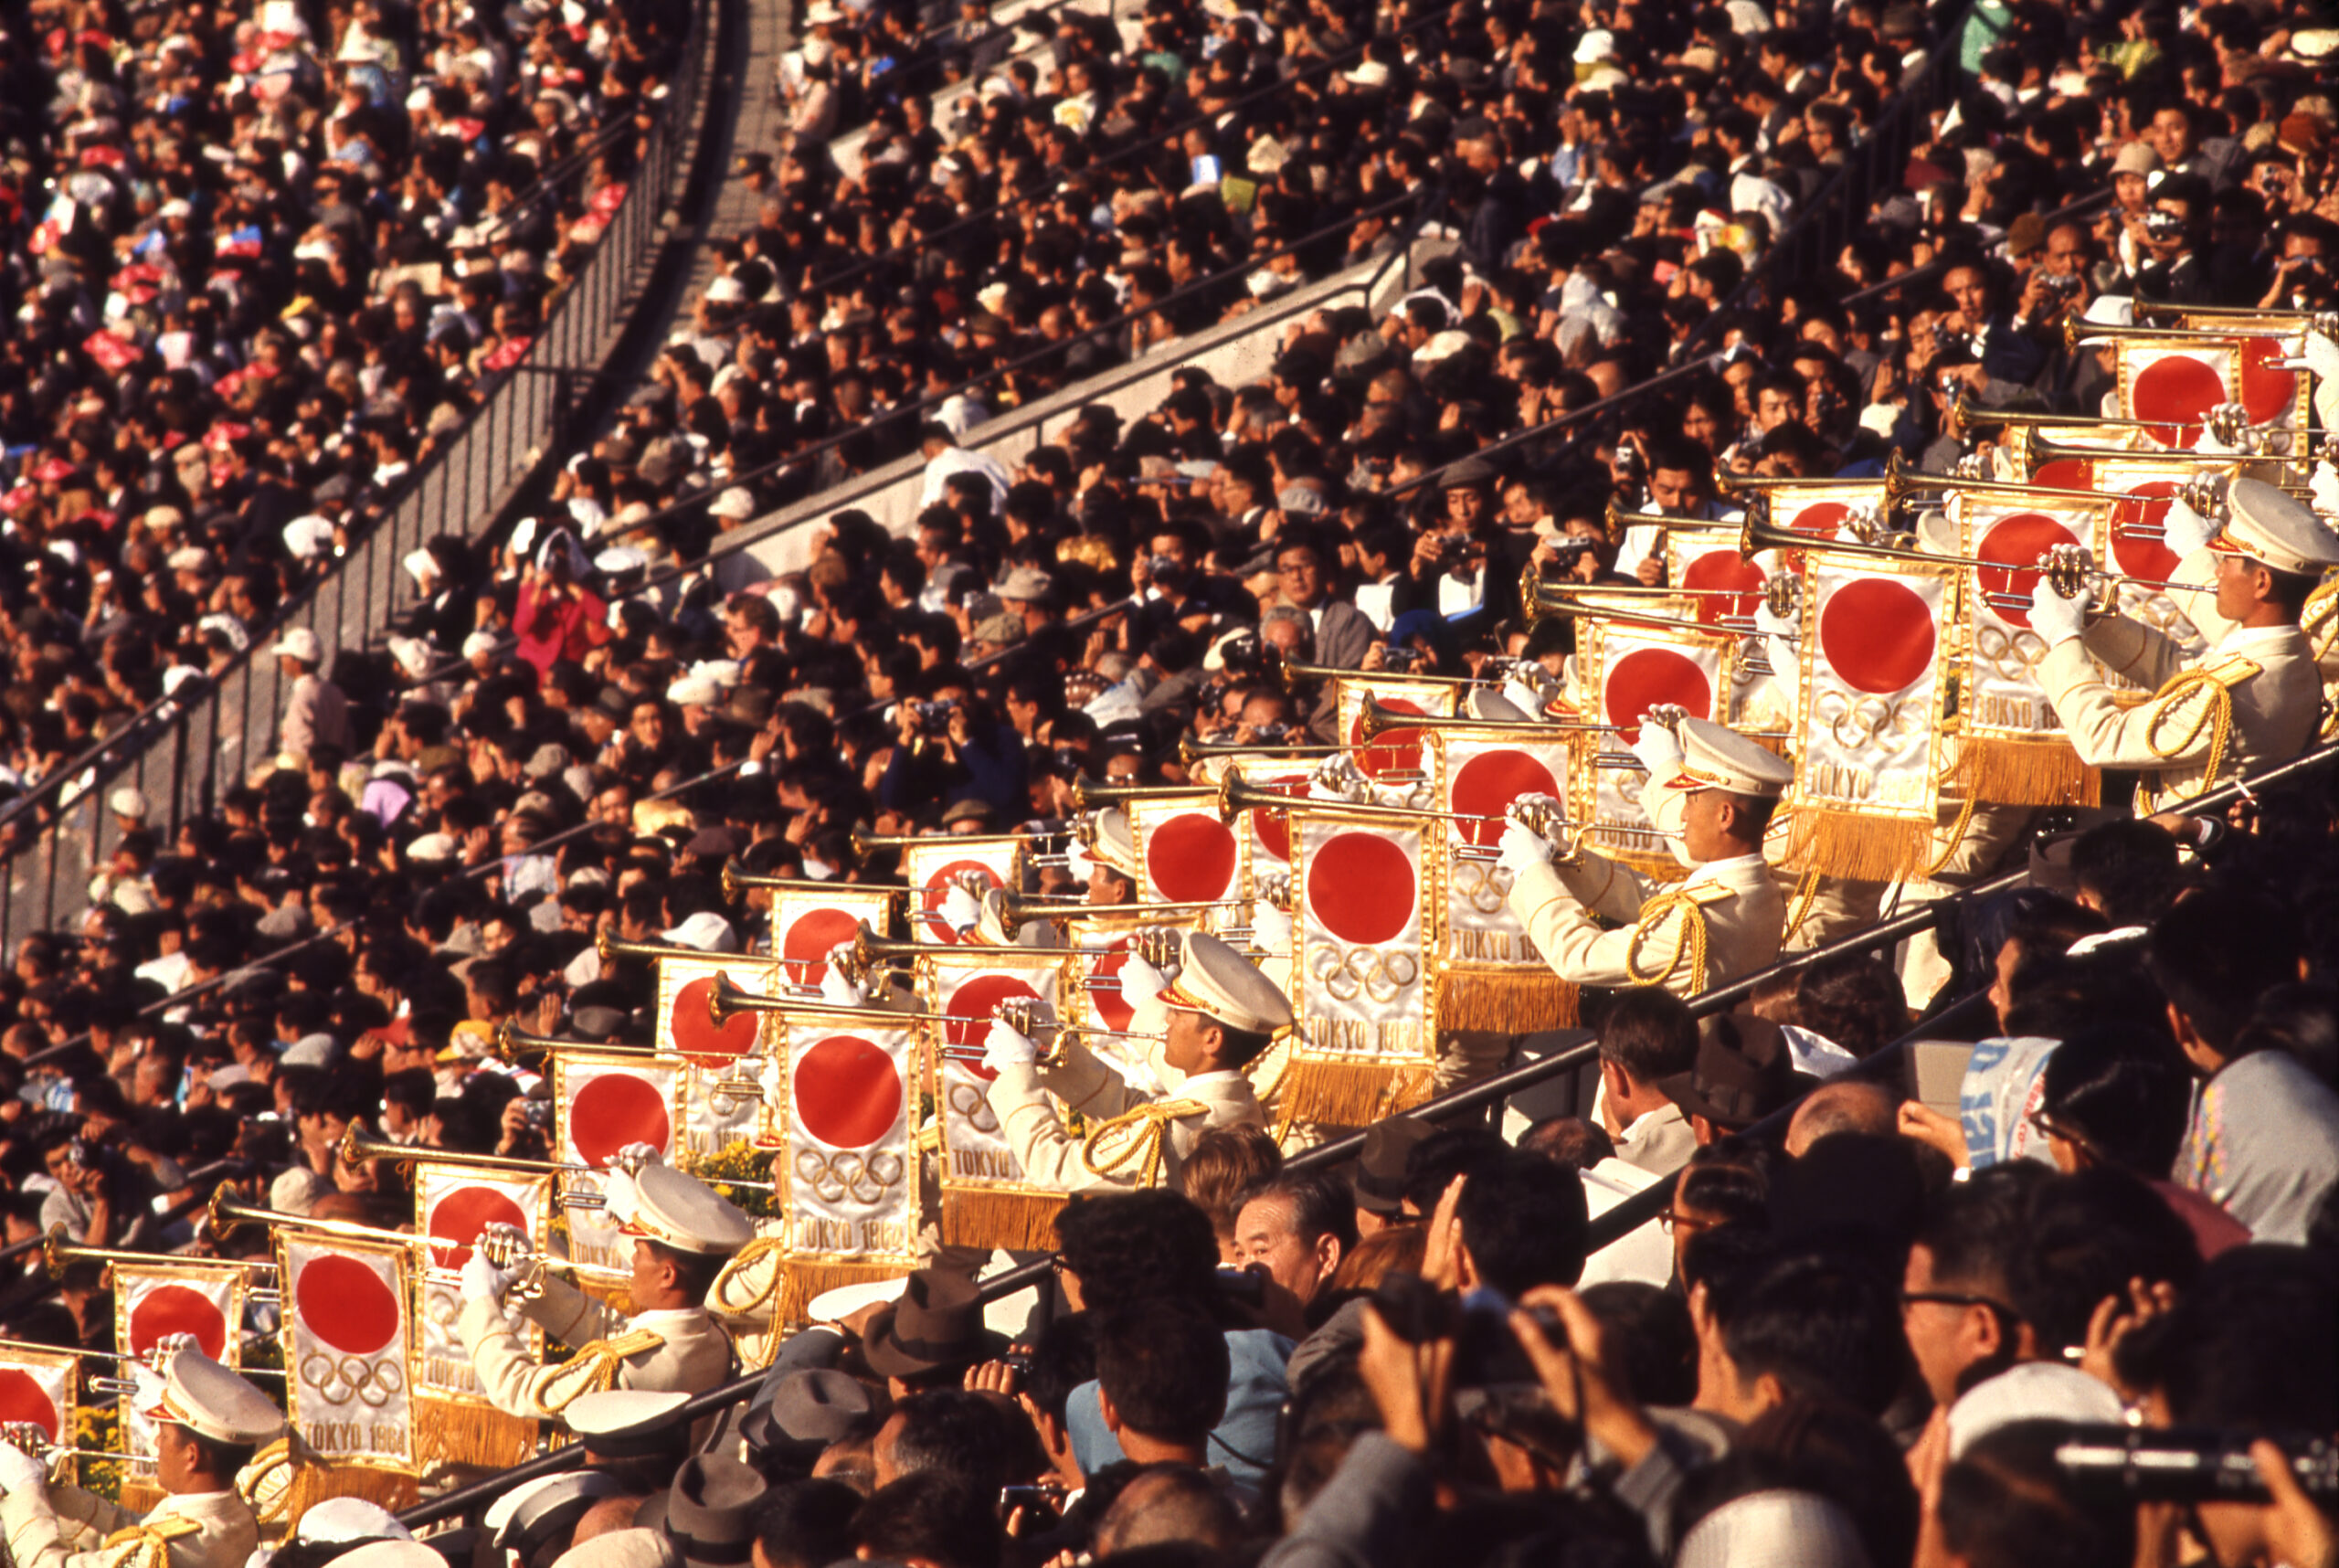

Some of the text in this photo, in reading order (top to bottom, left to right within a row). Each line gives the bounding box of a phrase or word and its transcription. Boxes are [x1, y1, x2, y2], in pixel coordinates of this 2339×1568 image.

[1976, 694, 2032, 728] TOKYO
[1810, 762, 1870, 800] TOKYO
[1452, 927, 1511, 960] TOKYO
[1308, 1016, 1366, 1050] TOKYO
[951, 1147, 1010, 1178] TOKYO
[798, 1216, 852, 1250] TOKYO
[304, 1421, 407, 1456] TOKYO 1964
